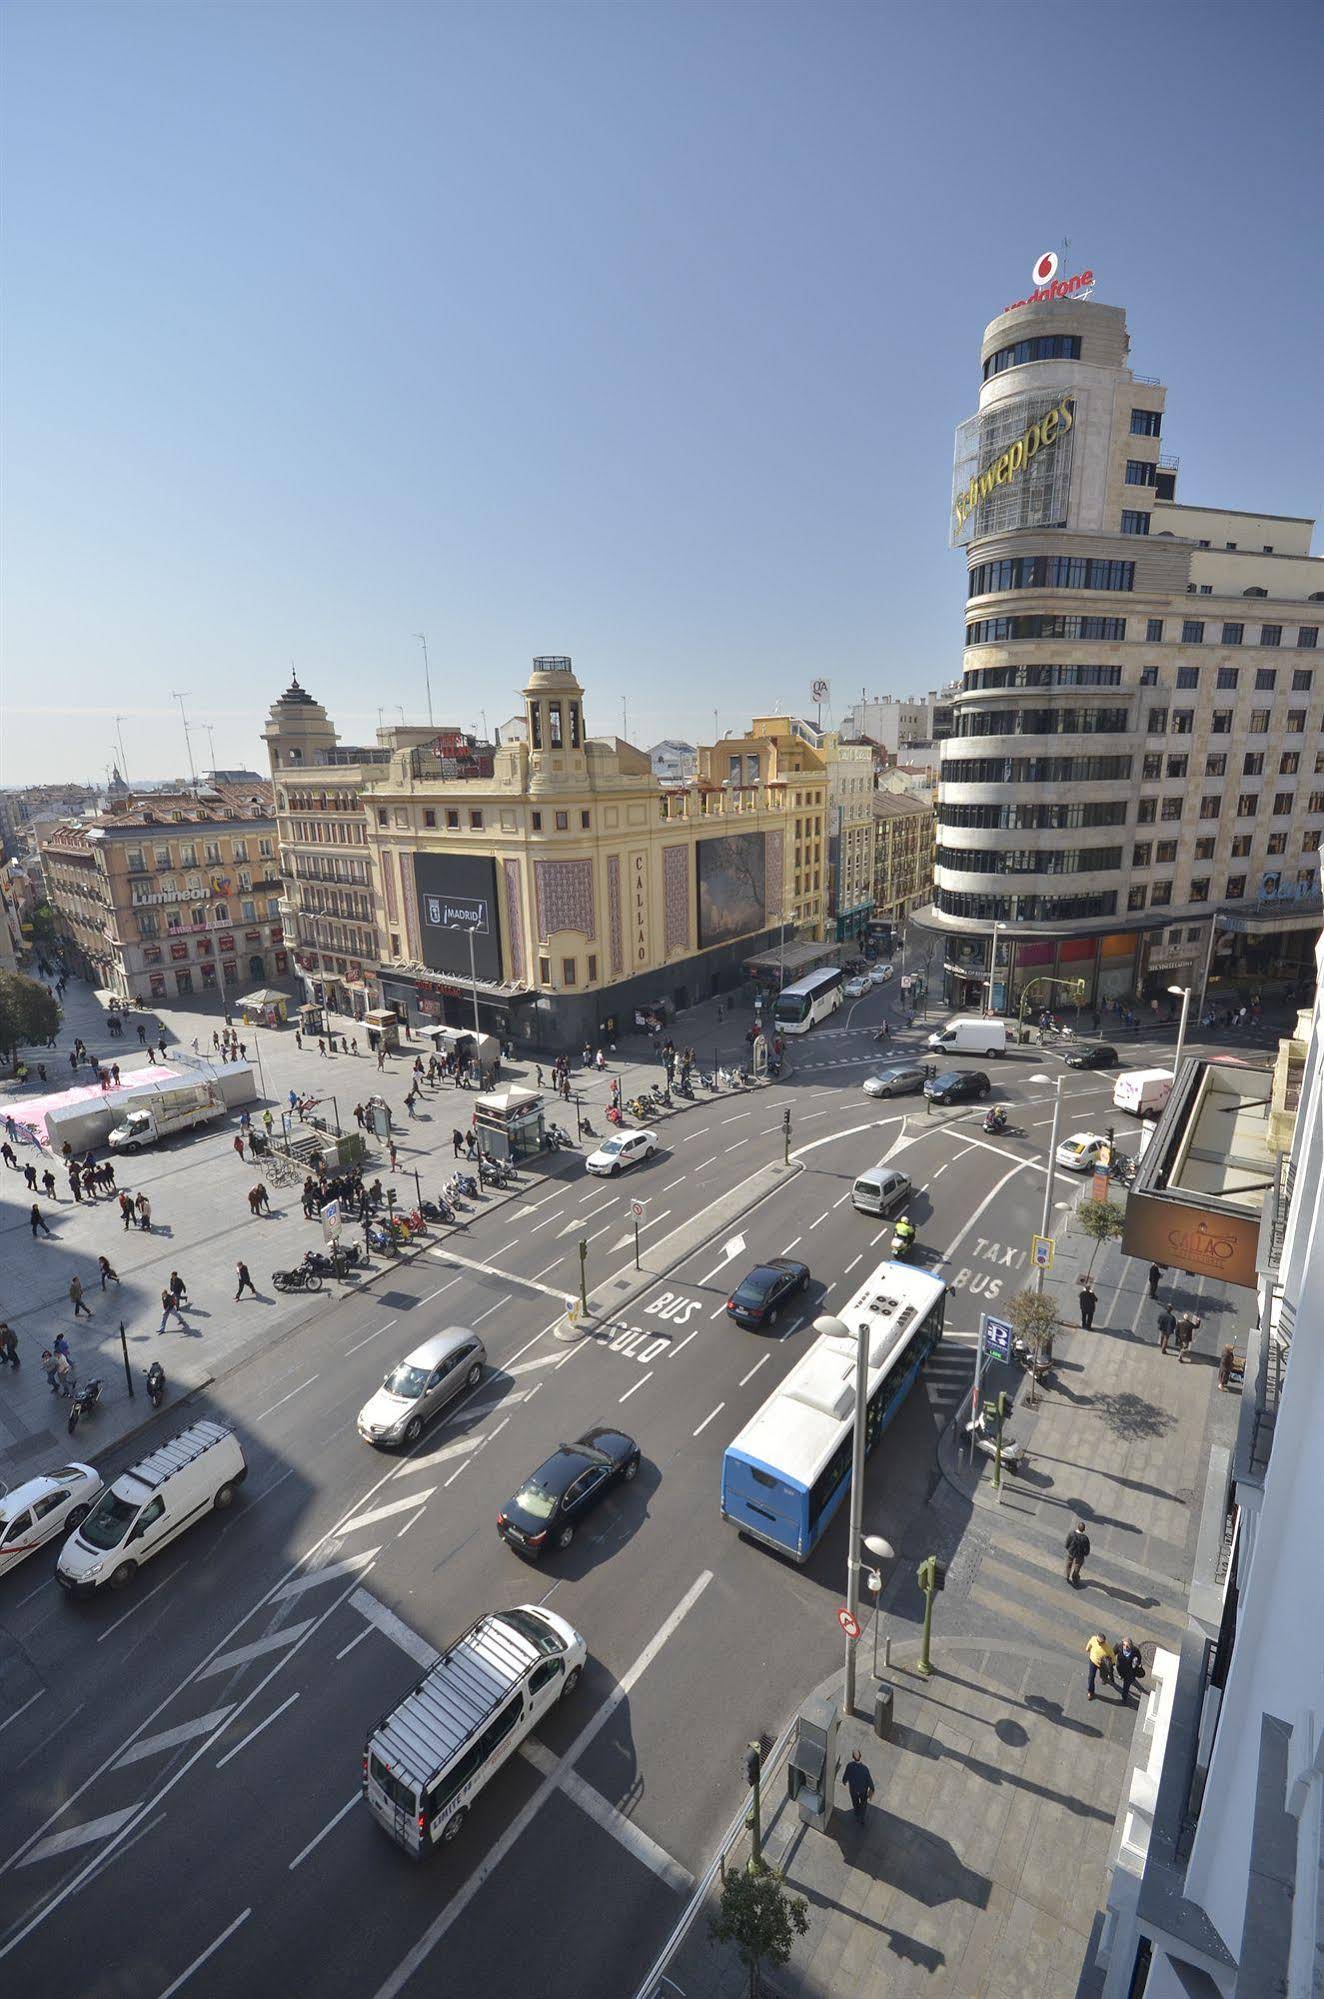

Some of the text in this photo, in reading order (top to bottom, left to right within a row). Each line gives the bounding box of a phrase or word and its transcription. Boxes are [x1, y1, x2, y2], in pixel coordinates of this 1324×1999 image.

[954, 394, 1073, 535] Schweppes
[443, 904, 483, 925] ¡MADRID!
[635, 856, 645, 961] CALLAO
[972, 1238, 1028, 1270] TAXI
[950, 1268, 1004, 1299] BUS
[643, 1291, 703, 1324] BUS
[596, 1321, 672, 1363] SOLO
